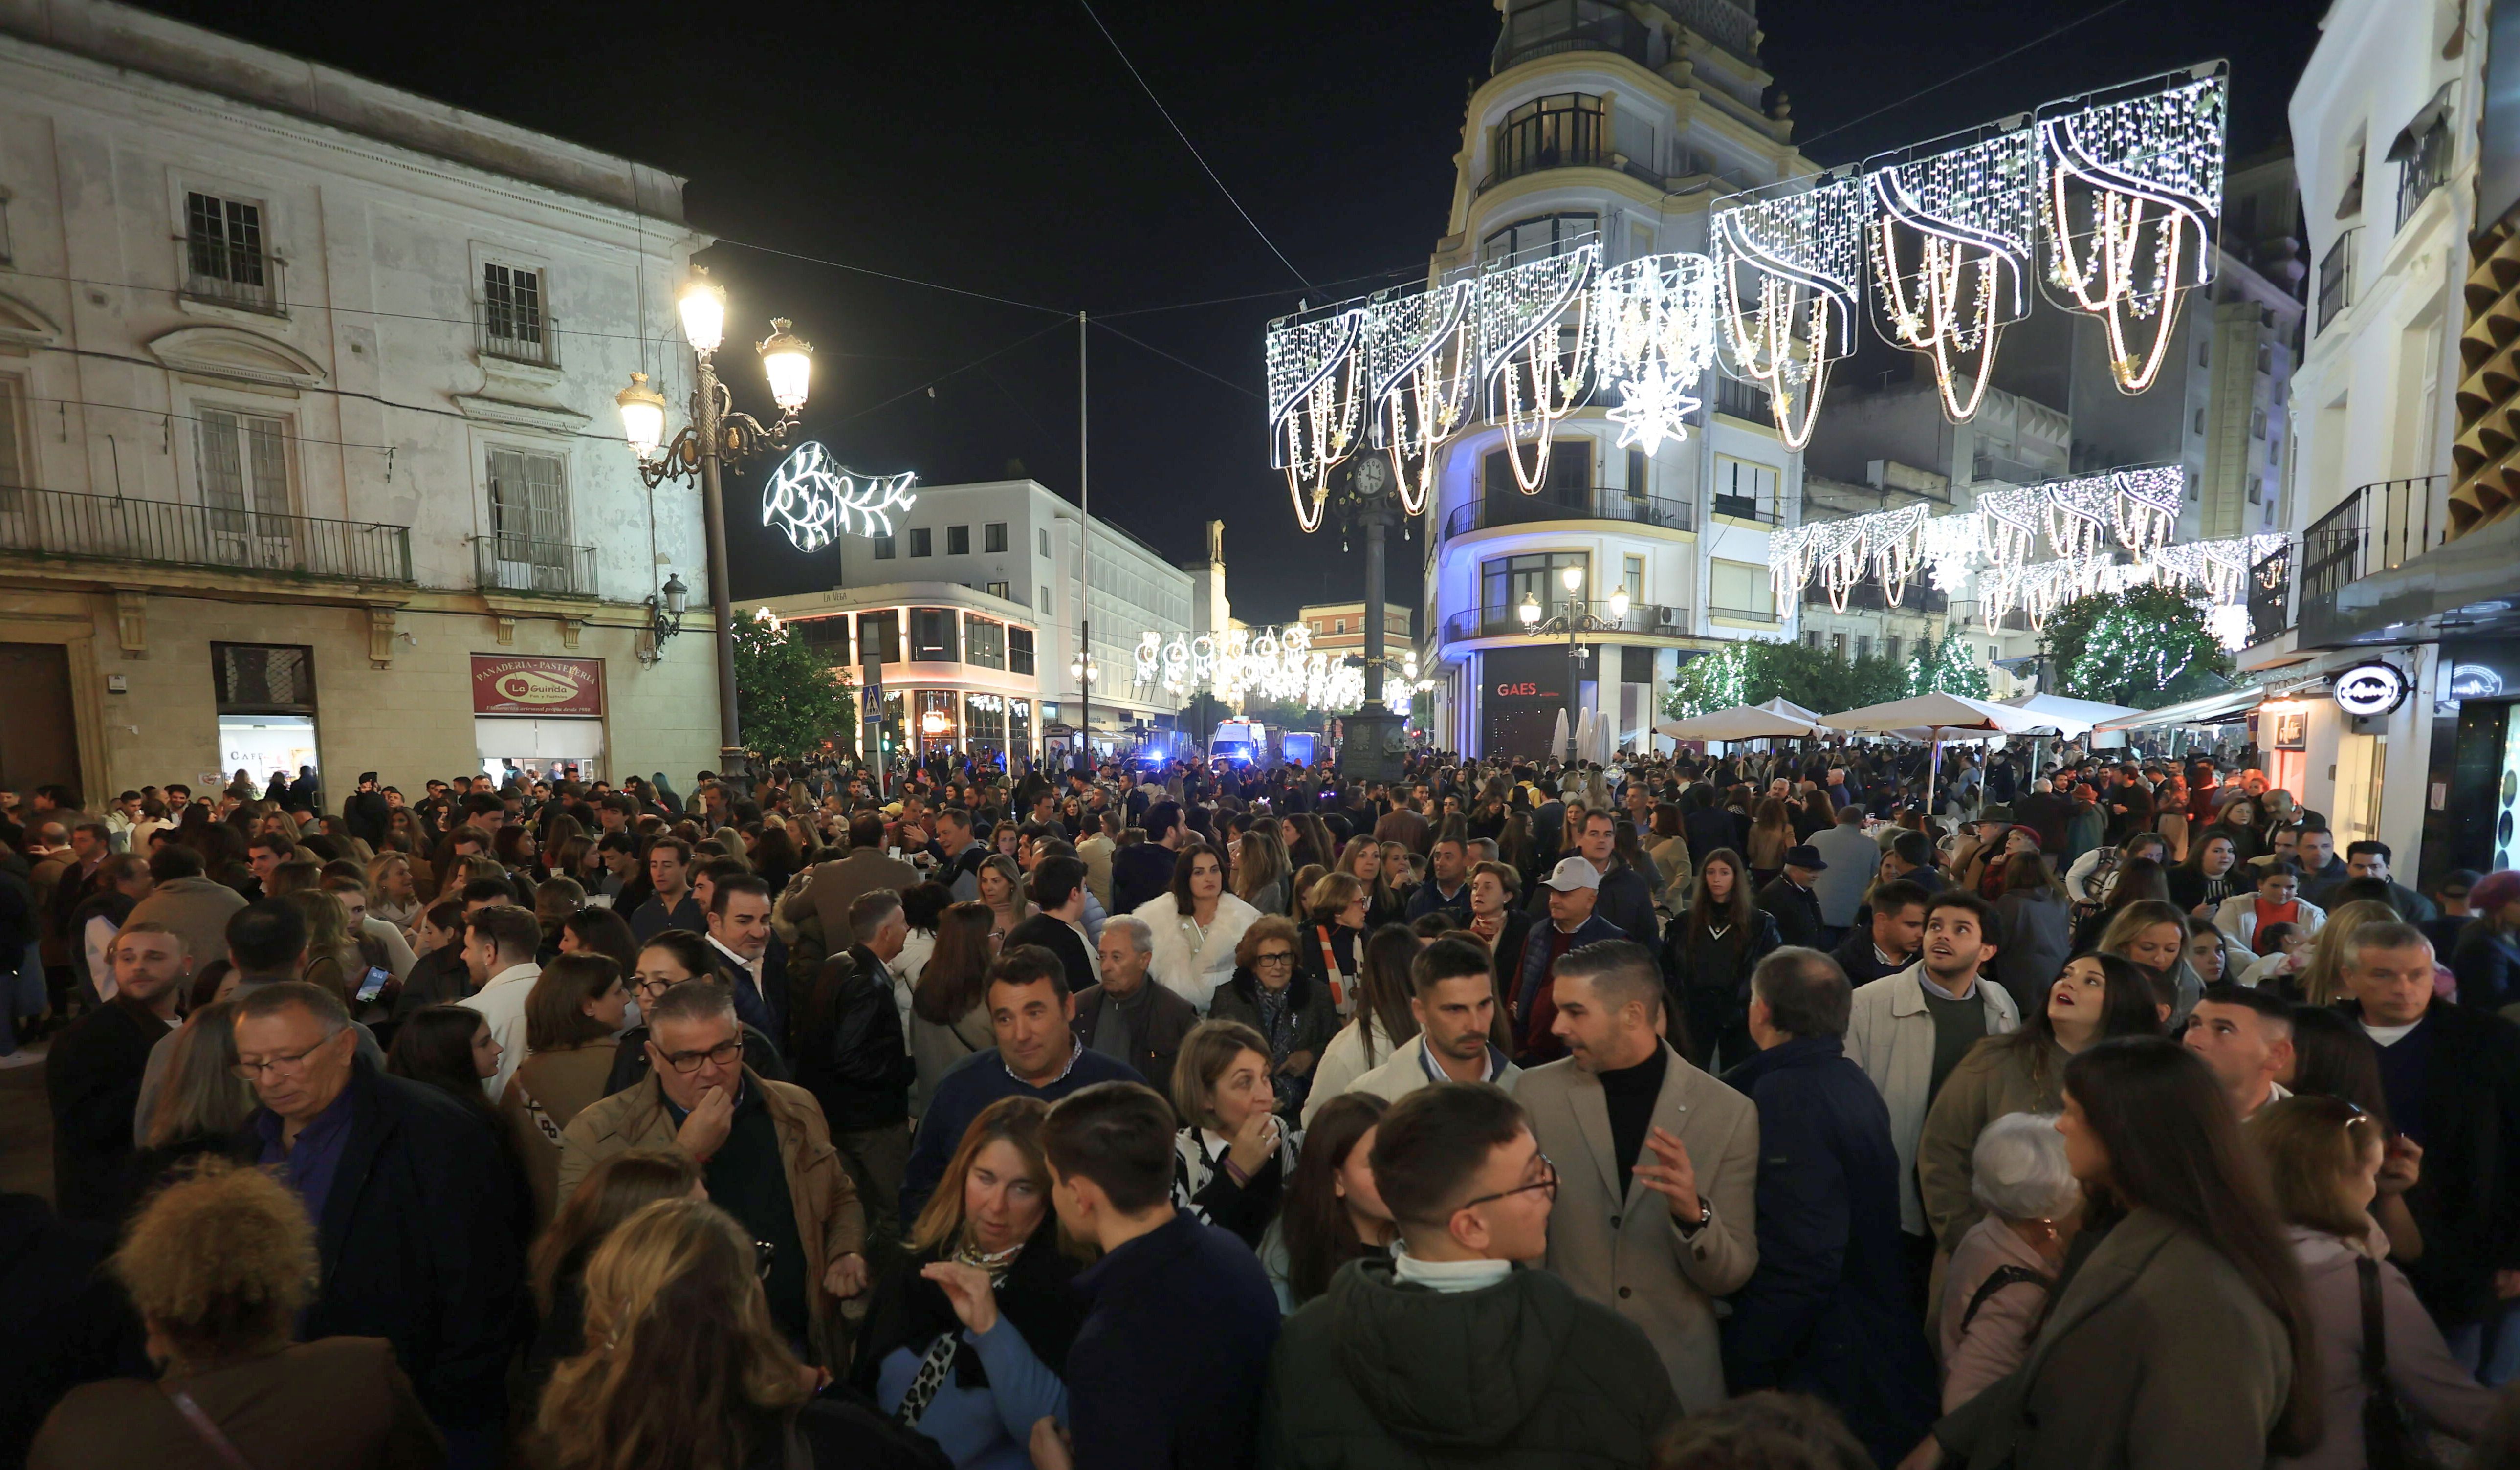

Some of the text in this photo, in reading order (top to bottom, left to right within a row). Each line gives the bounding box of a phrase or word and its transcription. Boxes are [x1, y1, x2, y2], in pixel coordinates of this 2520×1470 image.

[823, 592, 847, 602] LA VEGA
[476, 661, 532, 681] PANADERIA
[540, 661, 595, 685] PASTELERIA
[530, 685, 567, 693] Guinda
[1497, 682, 1537, 696] GAES
